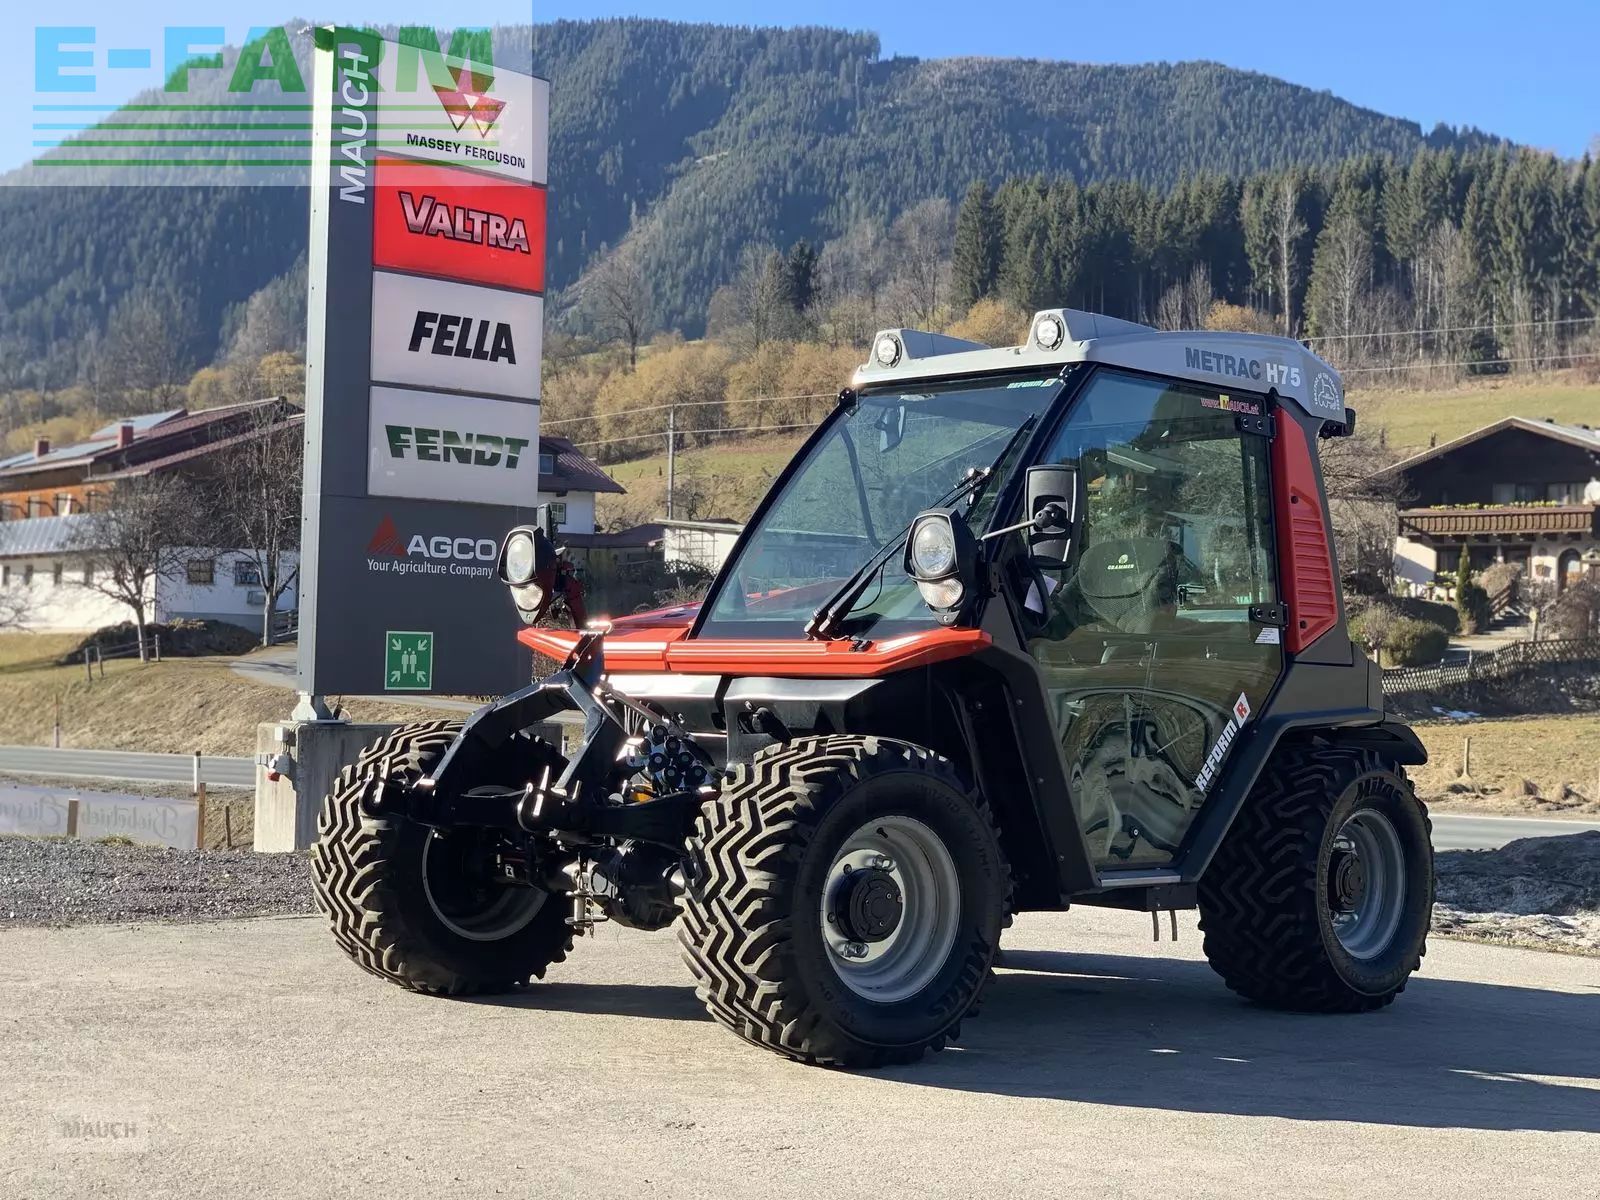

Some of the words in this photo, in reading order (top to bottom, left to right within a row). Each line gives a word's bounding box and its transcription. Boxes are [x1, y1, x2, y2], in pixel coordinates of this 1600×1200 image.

[340, 51, 369, 204] MAUCH
[407, 134, 460, 154] MASSEY
[465, 145, 525, 168] FERGUSON
[398, 191, 531, 254] VALTRA
[408, 311, 516, 364] FELLA
[1185, 347, 1260, 380] METRAC
[1266, 363, 1300, 387] H75
[385, 424, 529, 469] FENDT
[367, 559, 390, 572] Your
[391, 561, 446, 575] Agriculture
[449, 563, 494, 579] Company
[407, 535, 497, 560] AGCO
[1195, 719, 1238, 792] REFORM
